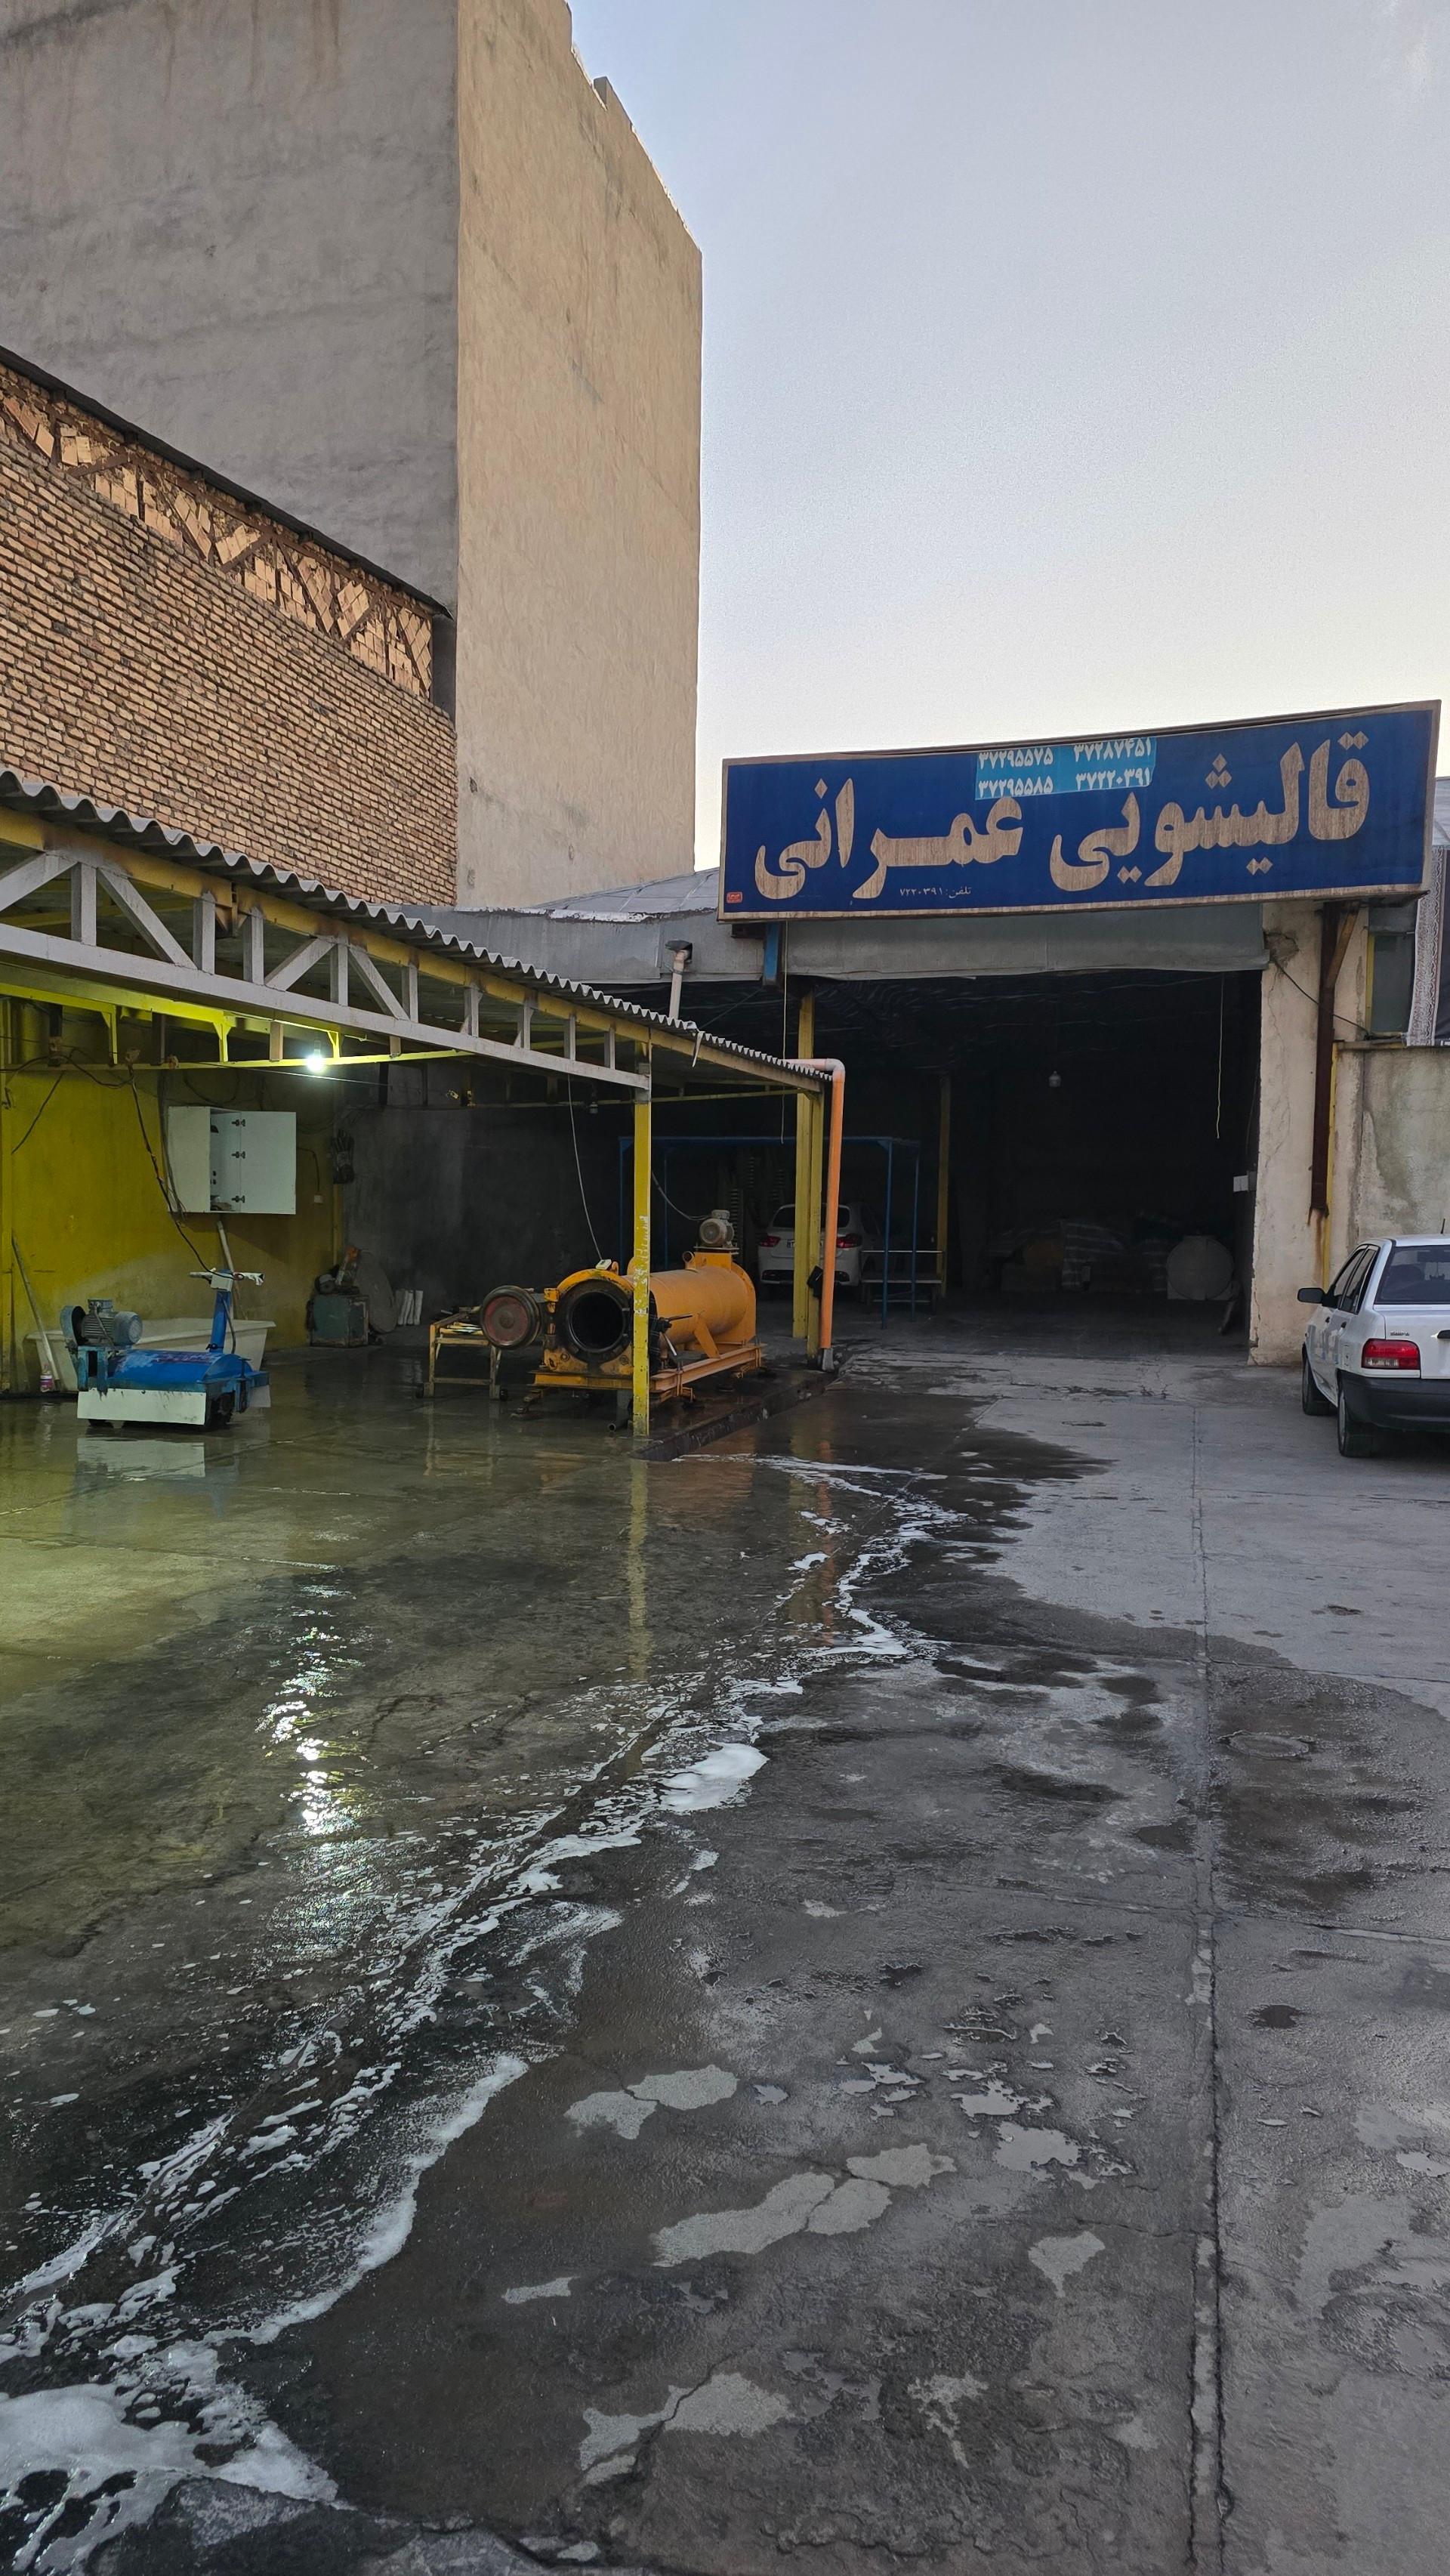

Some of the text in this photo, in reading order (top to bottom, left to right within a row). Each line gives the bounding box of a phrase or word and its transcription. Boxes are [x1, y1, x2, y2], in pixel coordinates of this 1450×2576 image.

[979, 737, 1151, 770] ۳۷۲۸۷۴۵۱ ۳۷۲۹۵۵۷۵
[978, 768, 1150, 798] ۳۷۲۲۰۳۹۱ ۳۷۲۹۵۵۸۵
[754, 730, 1370, 900] قالیشویی عمرانی
